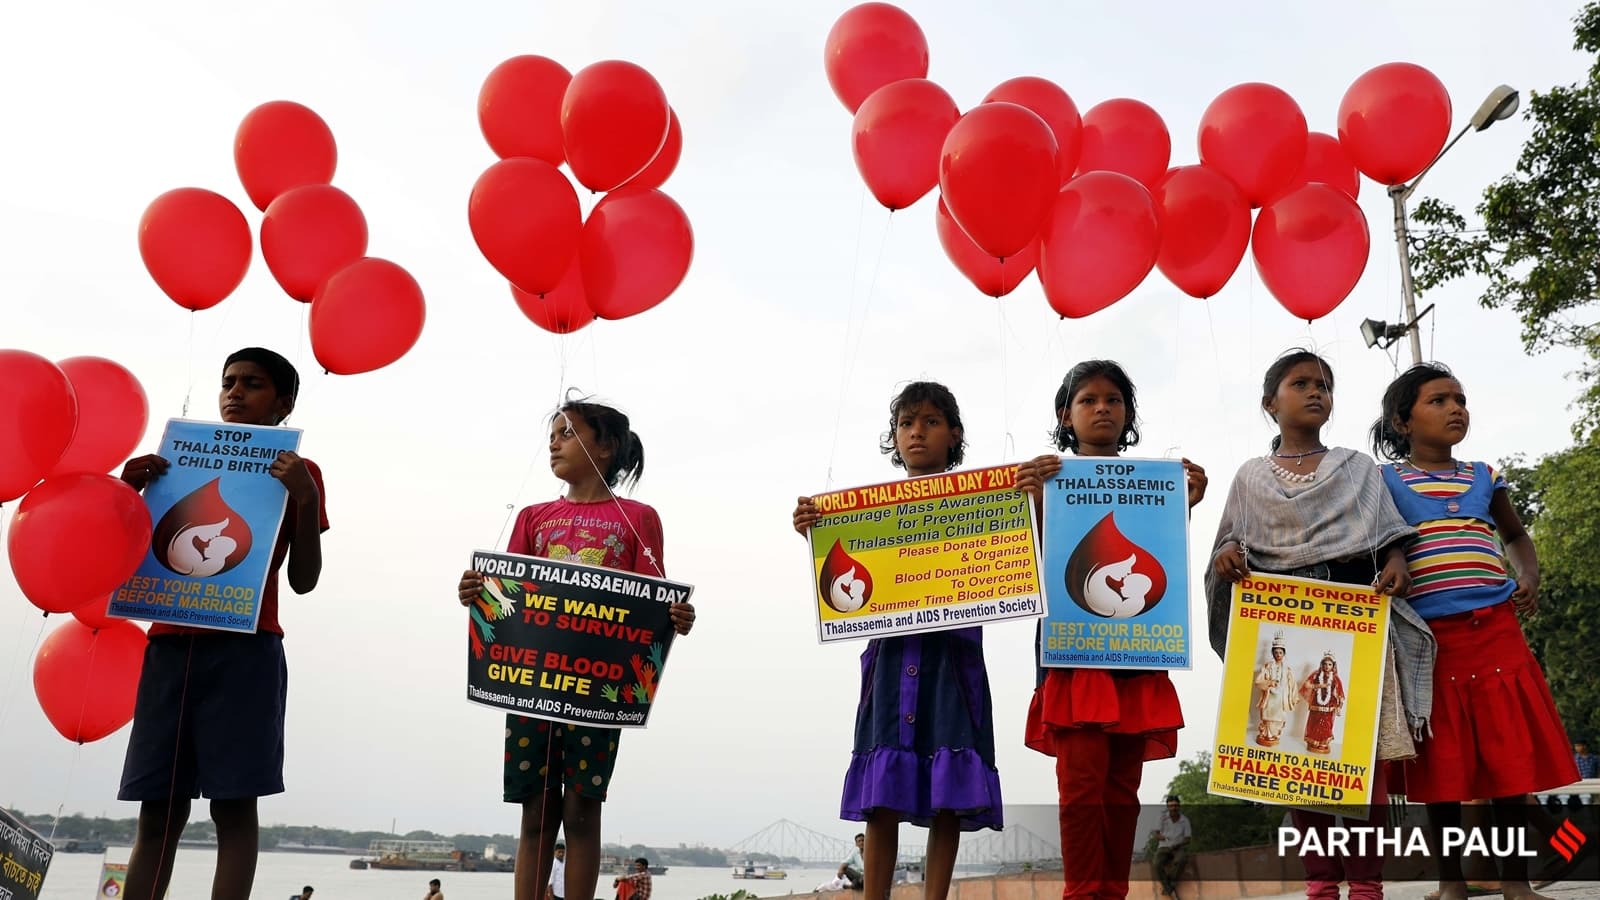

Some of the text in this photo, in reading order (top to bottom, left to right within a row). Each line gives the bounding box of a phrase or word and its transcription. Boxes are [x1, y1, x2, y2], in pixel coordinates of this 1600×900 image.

[214, 430, 252, 443] STOP
[178, 456, 271, 474] CHILD BIRTH
[1095, 464, 1135, 475] STOP
[860, 480, 956, 506] THALASSEMIA
[960, 472, 983, 491] DAY
[1055, 478, 1176, 492] THALASSAEMIC
[814, 490, 1022, 529] Encourage Mass Awareness
[1066, 493, 1165, 506] CHILD BIRTH
[573, 515, 628, 537] Butterfly
[897, 501, 1025, 531] for Prevention of
[848, 517, 1026, 551] Thalassemia Child Birth
[899, 531, 1027, 558] Please Donate Blood
[961, 545, 1029, 562] & Organize
[474, 557, 687, 603] WORLD THALASSAEMIA DAY
[895, 558, 1031, 584] Blood Donation Camp
[951, 571, 1032, 589] To Overcome
[117, 588, 253, 615] BEFORE MARRIAGE
[163, 579, 201, 594] YOUR
[205, 585, 254, 600] BLOOD
[869, 582, 1034, 613] Summer Time Blood Crisis
[1241, 579, 1381, 605] DON'T IGNORE
[111, 603, 252, 627] Thalassaemia and AIDS Prevention Society
[525, 593, 630, 623] WE WANT
[825, 598, 1037, 636] Thalassaemia and AIDS Prevention Society
[1241, 592, 1379, 618] BLOOD TEST
[522, 609, 654, 645] TO SURVIVE
[1050, 622, 1184, 638] TEST YOUR BLOOD
[1240, 607, 1377, 634] BEFORE MARRIAGE
[1044, 651, 1187, 666] Thalassaemia and AIDS Prevention Society
[1047, 637, 1185, 653] BEFORE MARRIAGE
[489, 644, 624, 680] GIVE BLOOD
[488, 663, 592, 695] GIVE LIFE
[469, 684, 645, 723] Thalassaemia and AIDS Prevention Society
[1218, 744, 1366, 777] GIVE BIRTH TO A HEALTHY
[1218, 755, 1364, 791] THALASSAEMIA
[1212, 781, 1260, 796] Thalassaemia
[1261, 789, 1275, 799] and
[1276, 791, 1293, 802] AIDS
[1295, 795, 1334, 808] Prevention
[1233, 771, 1344, 801] FREE CHILD
